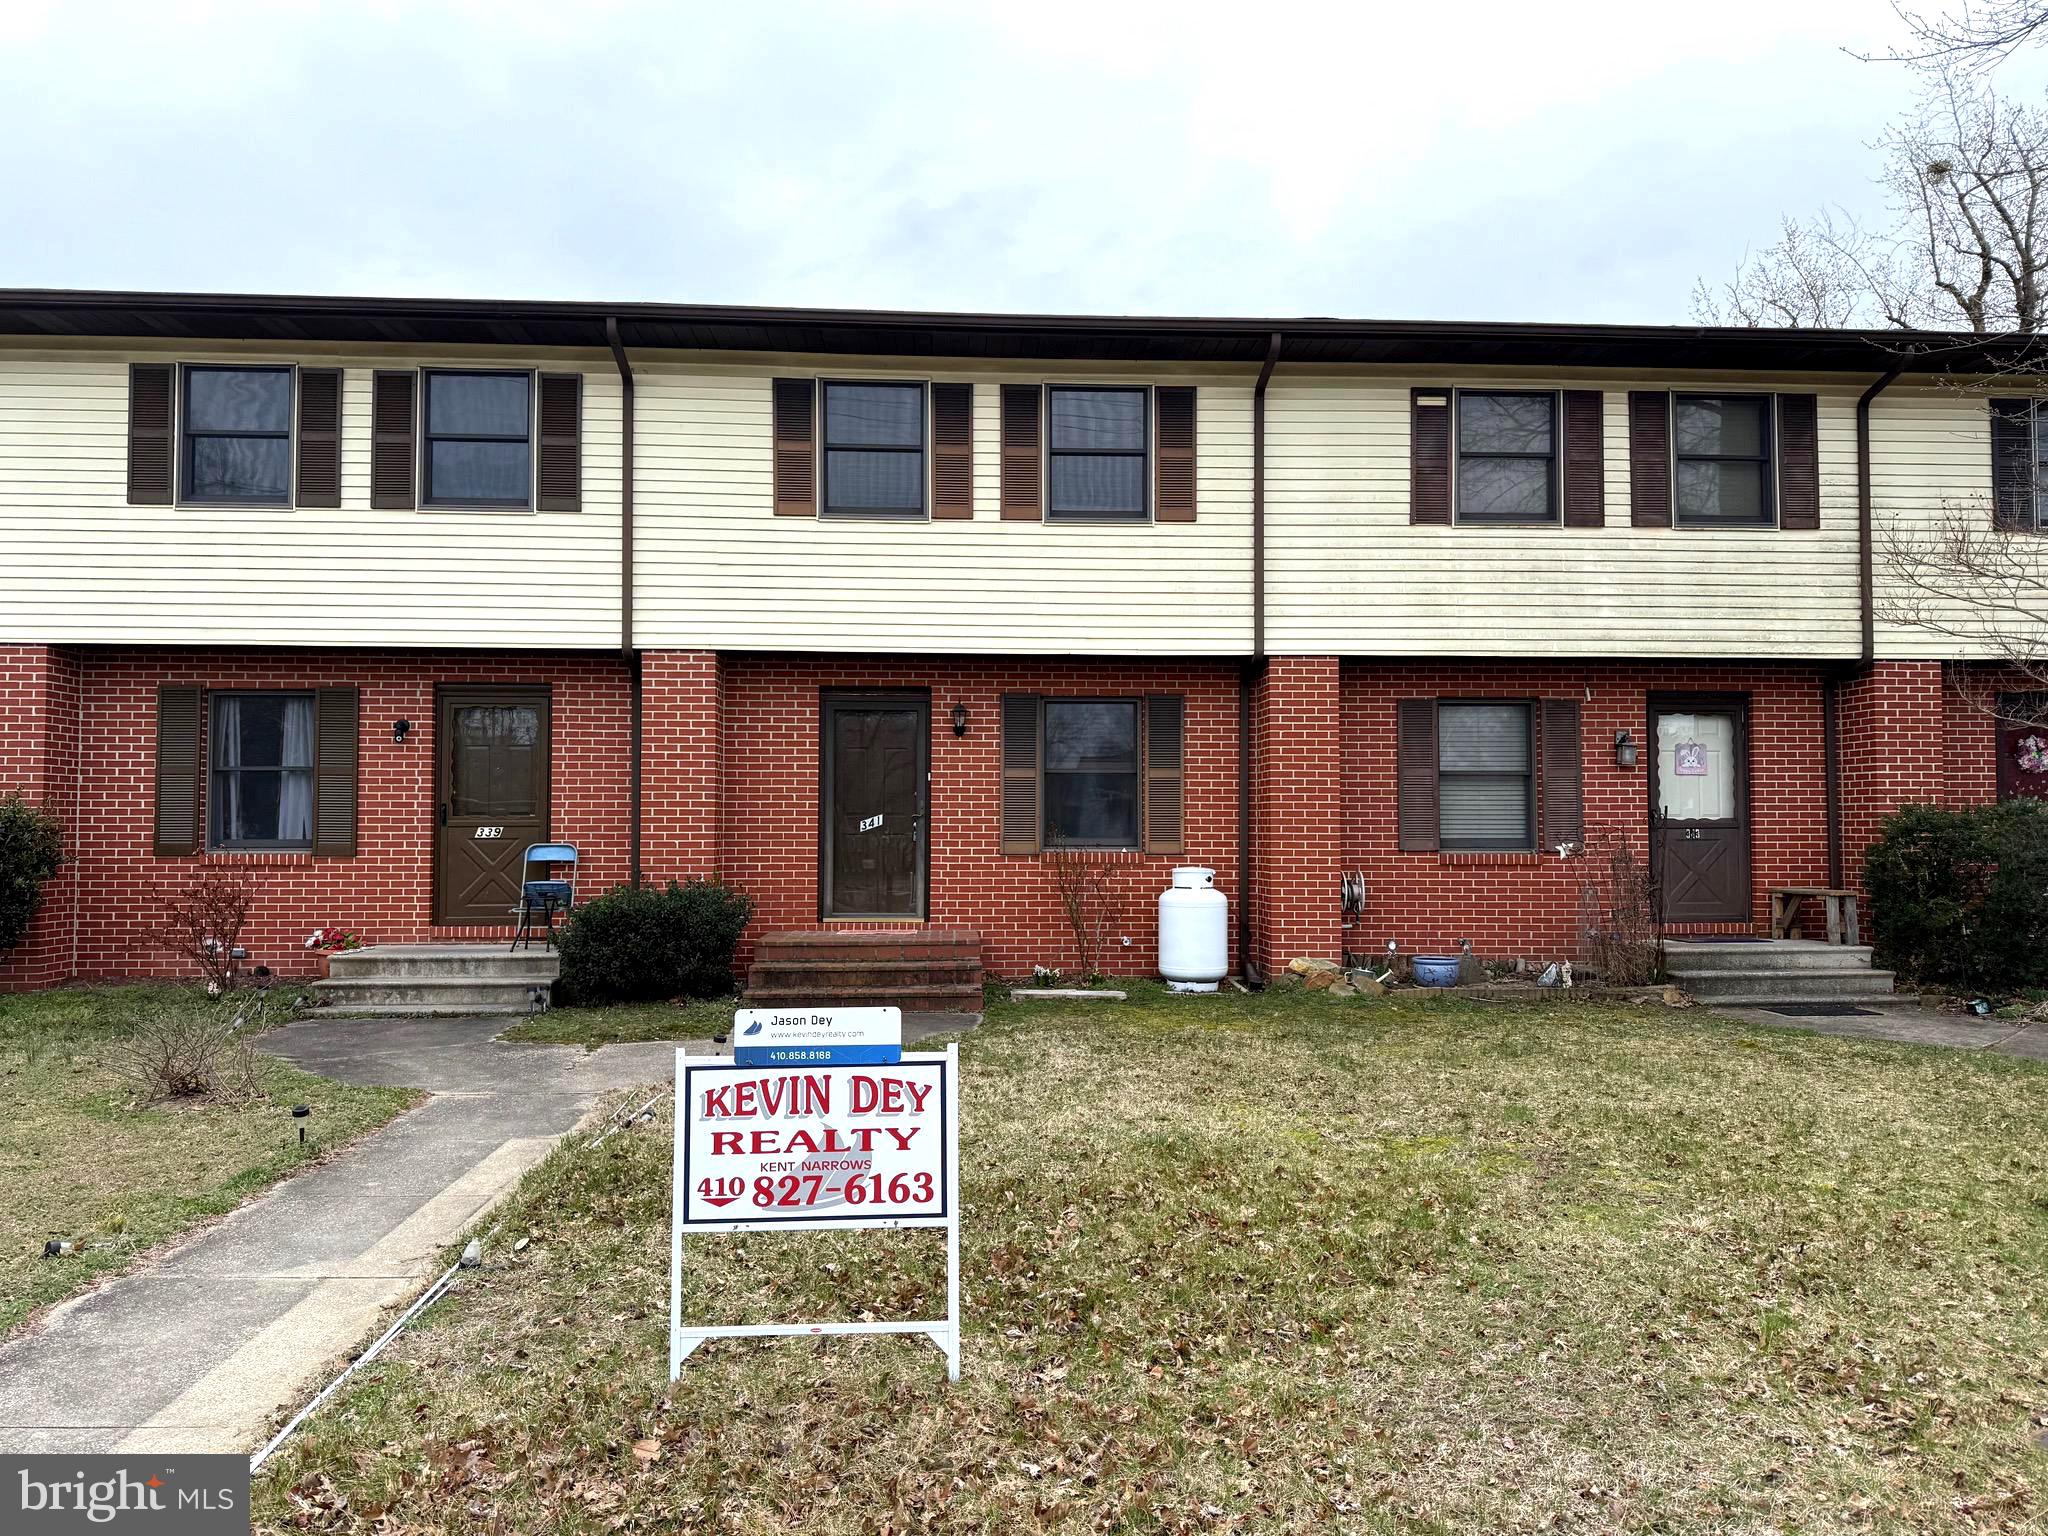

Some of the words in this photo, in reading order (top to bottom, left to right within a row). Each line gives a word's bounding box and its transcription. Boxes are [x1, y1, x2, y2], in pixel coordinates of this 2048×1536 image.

[861, 816, 880, 830] 341
[477, 827, 502, 837] 339
[770, 1015, 807, 1026] Jason
[811, 1015, 833, 1027] Dey
[703, 1074, 832, 1118] KEVIN
[851, 1075, 933, 1114] DEY
[710, 1127, 921, 1155] REALTY
[760, 1161, 796, 1172] KENT
[801, 1159, 872, 1171] NARROWS
[697, 1176, 745, 1197] 410
[752, 1172, 934, 1208] 827-6163
